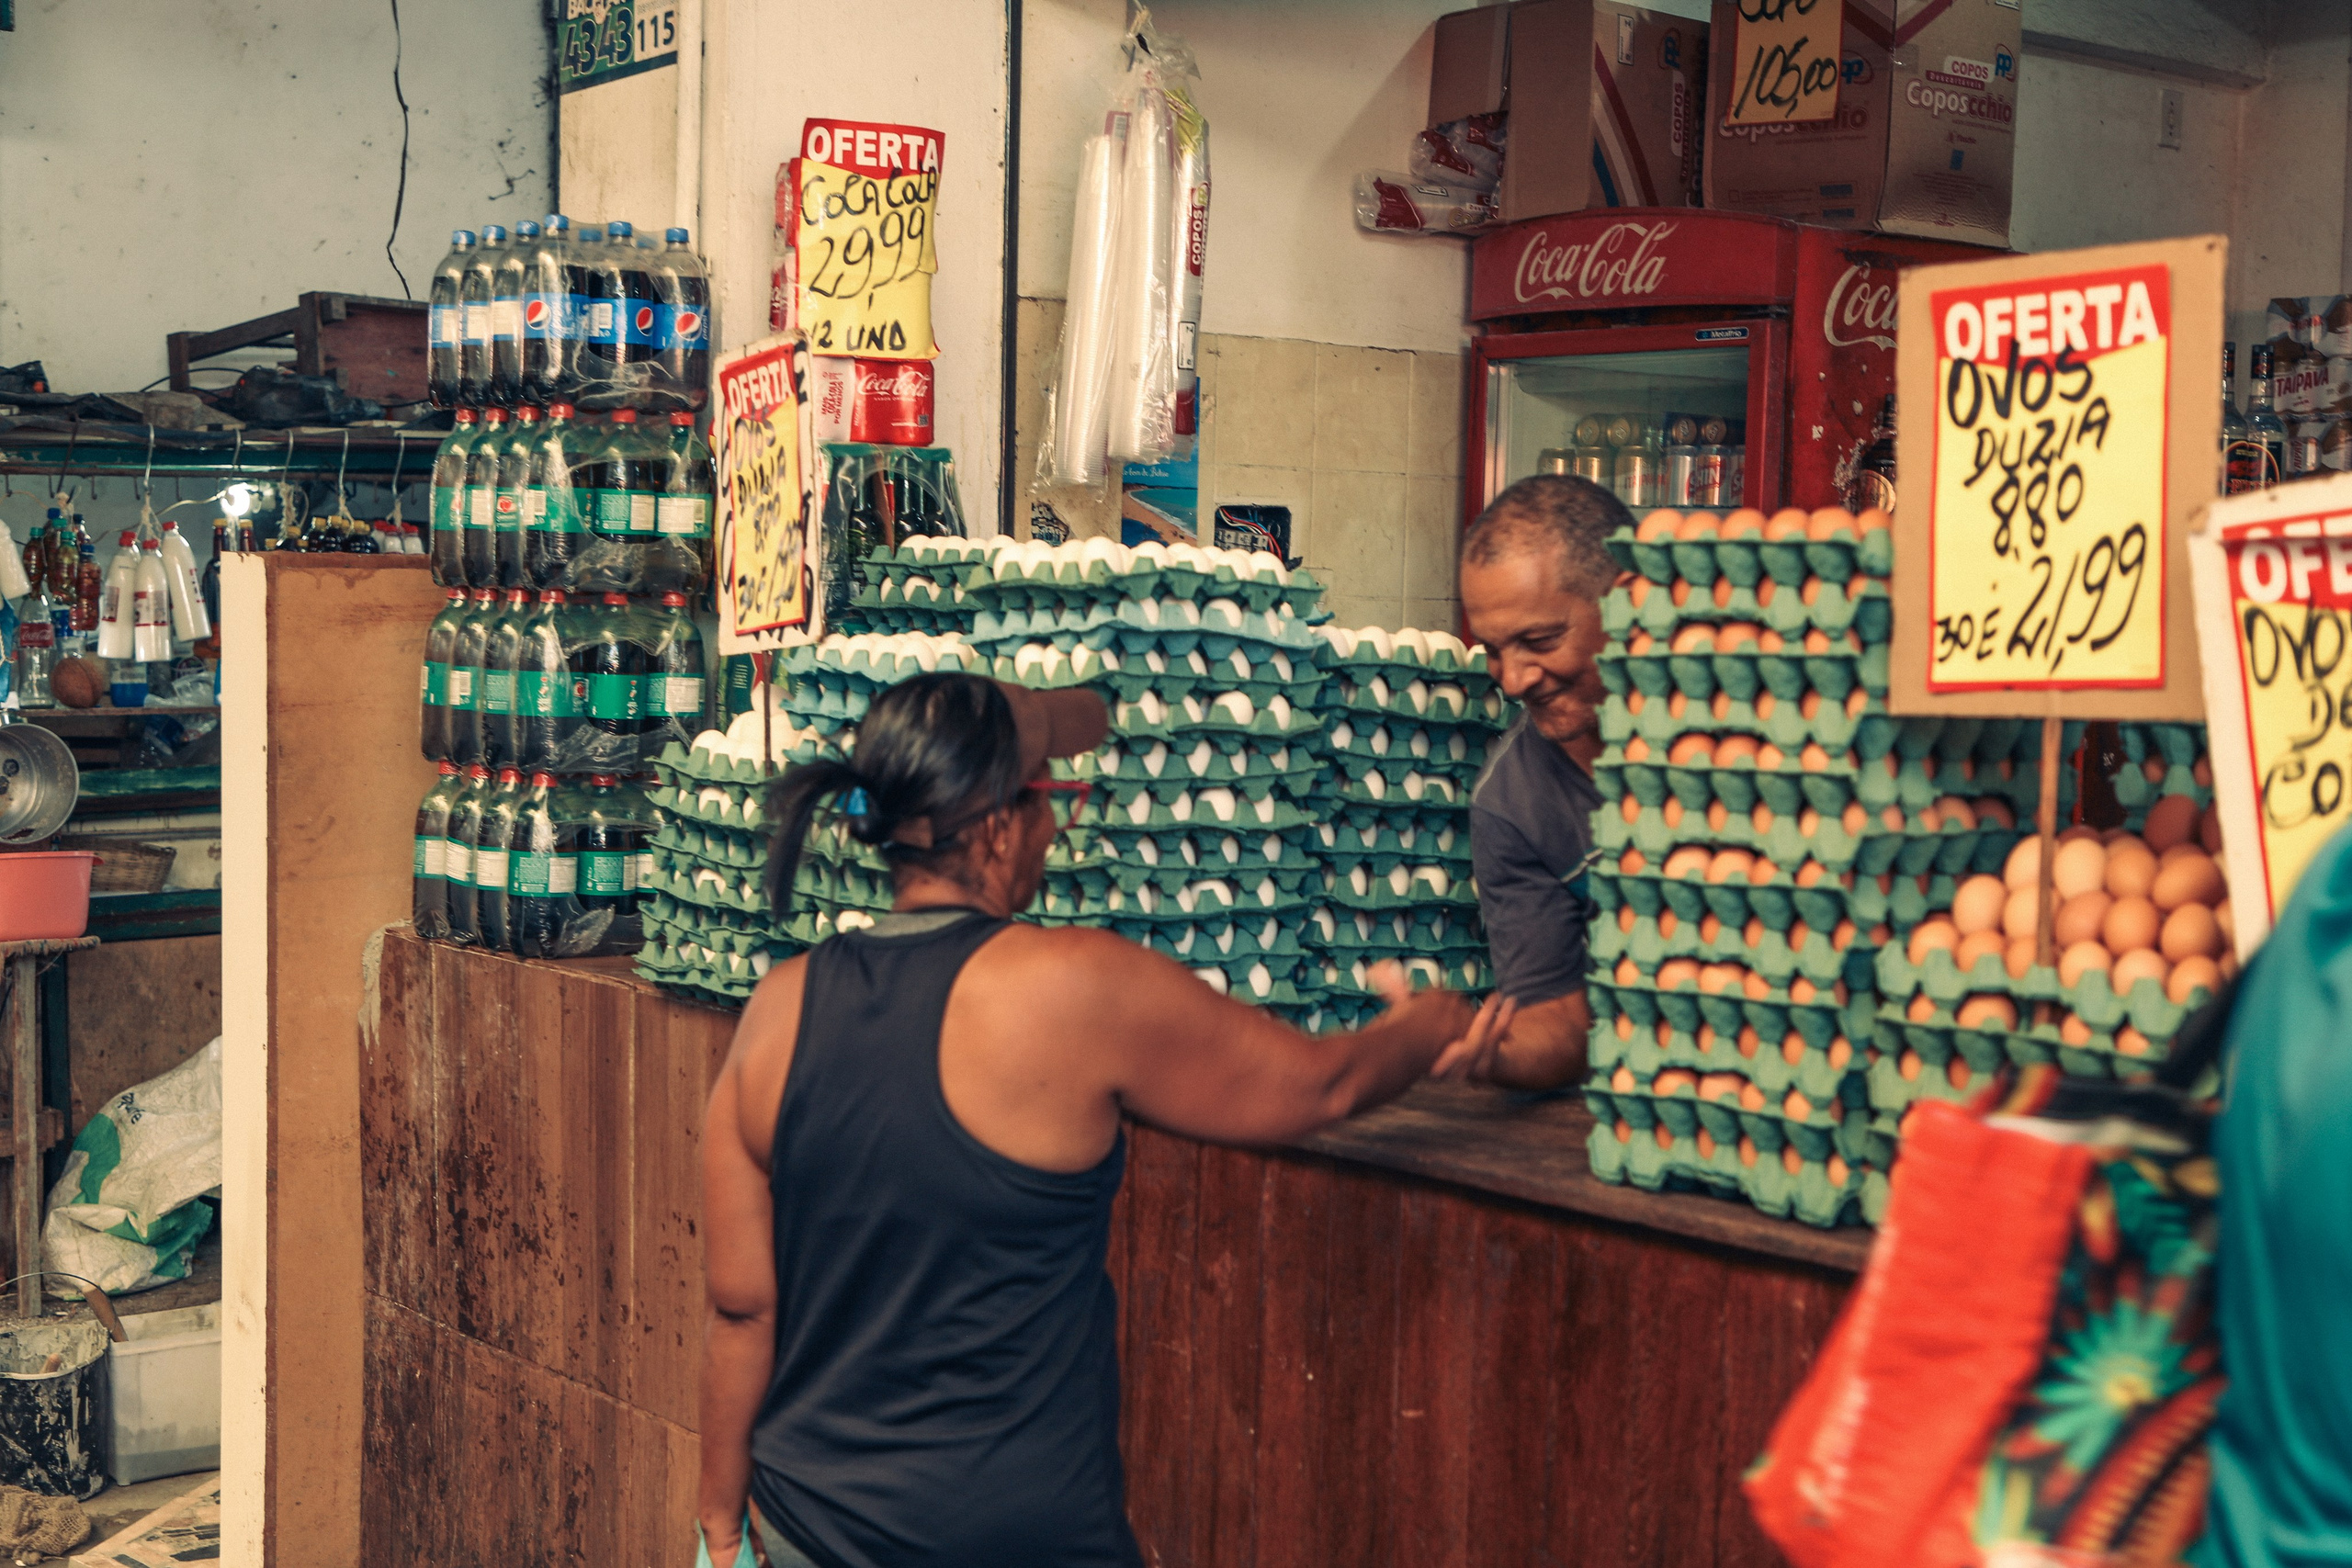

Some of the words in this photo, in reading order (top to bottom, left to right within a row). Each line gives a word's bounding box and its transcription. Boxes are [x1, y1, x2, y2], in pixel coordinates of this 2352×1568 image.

[560, 6, 634, 77] 4343
[638, 10, 675, 52] 115
[1951, 61, 1989, 80] COPOS
[1734, 37, 1838, 119] 105,00
[1907, 79, 2013, 125] Coposcchio
[1673, 83, 1684, 143] COPOS
[807, 126, 939, 172] OFERTA
[1192, 209, 1203, 265] COPOS
[846, 321, 907, 352] UND
[1944, 281, 2160, 362] OFERTA
[728, 358, 793, 418] OFERTA
[1947, 336, 2093, 429] OVOS
[1963, 396, 2111, 487] DUZIA
[1936, 614, 1974, 663] 30
[2007, 523, 2146, 675] 21,99
